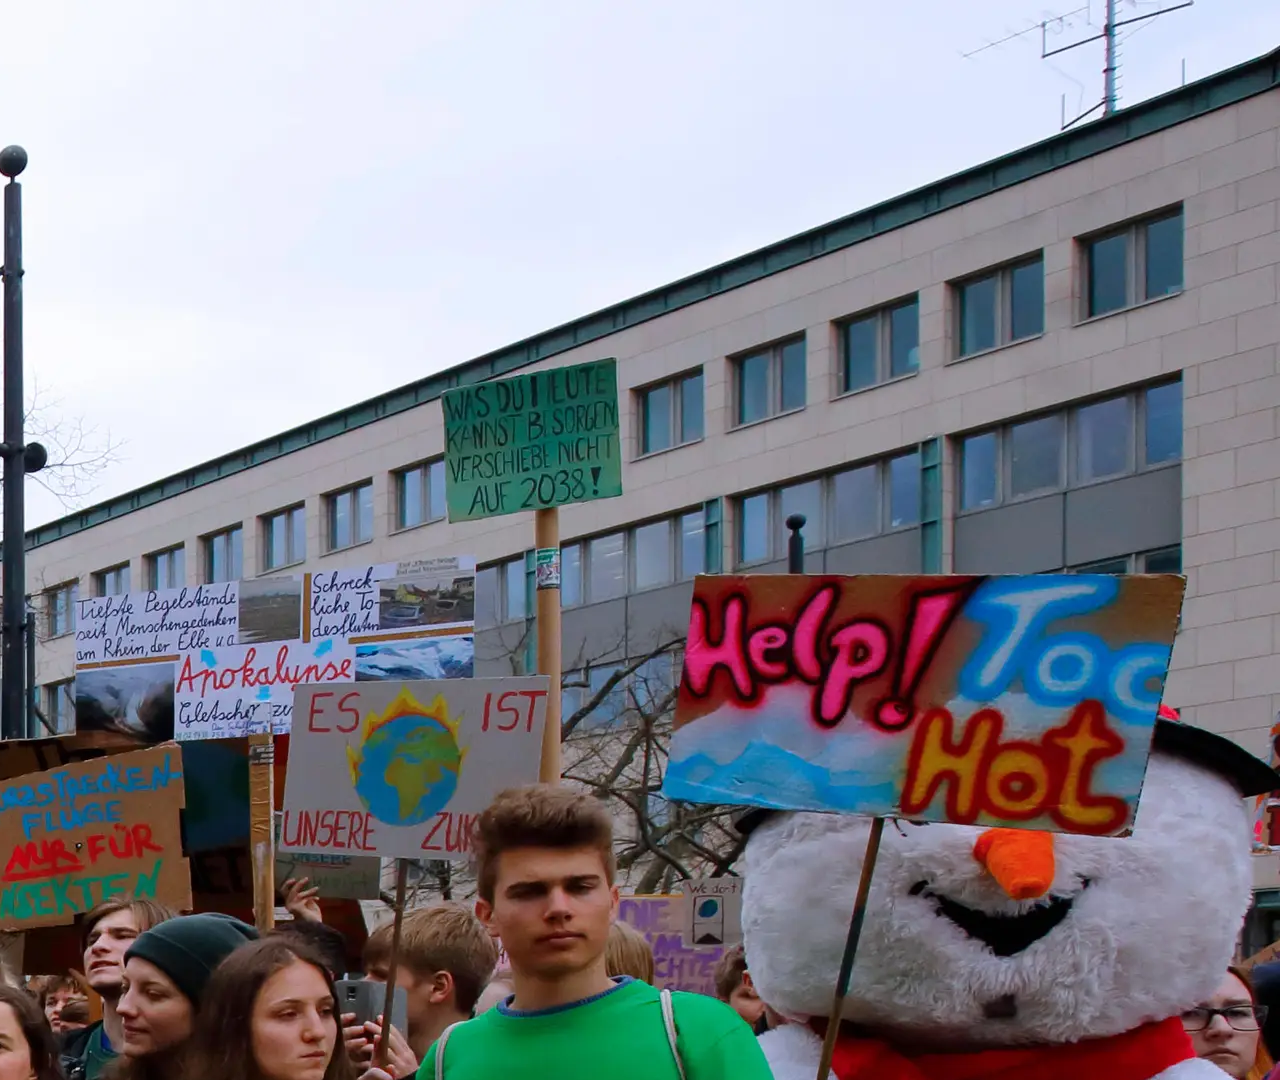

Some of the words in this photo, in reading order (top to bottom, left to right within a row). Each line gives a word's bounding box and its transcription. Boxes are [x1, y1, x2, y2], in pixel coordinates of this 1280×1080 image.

[446, 386, 490, 421] WAS
[497, 378, 524, 412] DU
[447, 414, 521, 453] KANNST
[529, 401, 618, 442] BESORGEN
[450, 445, 550, 483] VERSCHIEBE
[558, 434, 616, 465] NICHT
[468, 481, 511, 515] AUF
[521, 466, 602, 508] 2038!
[77, 594, 135, 621] Tiefste
[145, 583, 237, 619] Pegelstände
[311, 594, 350, 616] liche
[76, 621, 108, 641] seit
[116, 609, 237, 635] Menschengedenken
[76, 648, 96, 662] am
[104, 640, 149, 658] Rhein,
[150, 638, 169, 653] der
[178, 631, 210, 651] Elbe
[176, 645, 352, 698] Apokalypse
[683, 582, 975, 732] Help!
[308, 692, 361, 733] ES
[481, 690, 549, 732] IST
[902, 704, 1131, 832] Hot
[22, 801, 124, 839] FLÜGE
[283, 810, 377, 851] UNSERE
[421, 811, 481, 852] ZUK
[4, 838, 81, 874] NUR
[87, 824, 164, 864] FÜR
